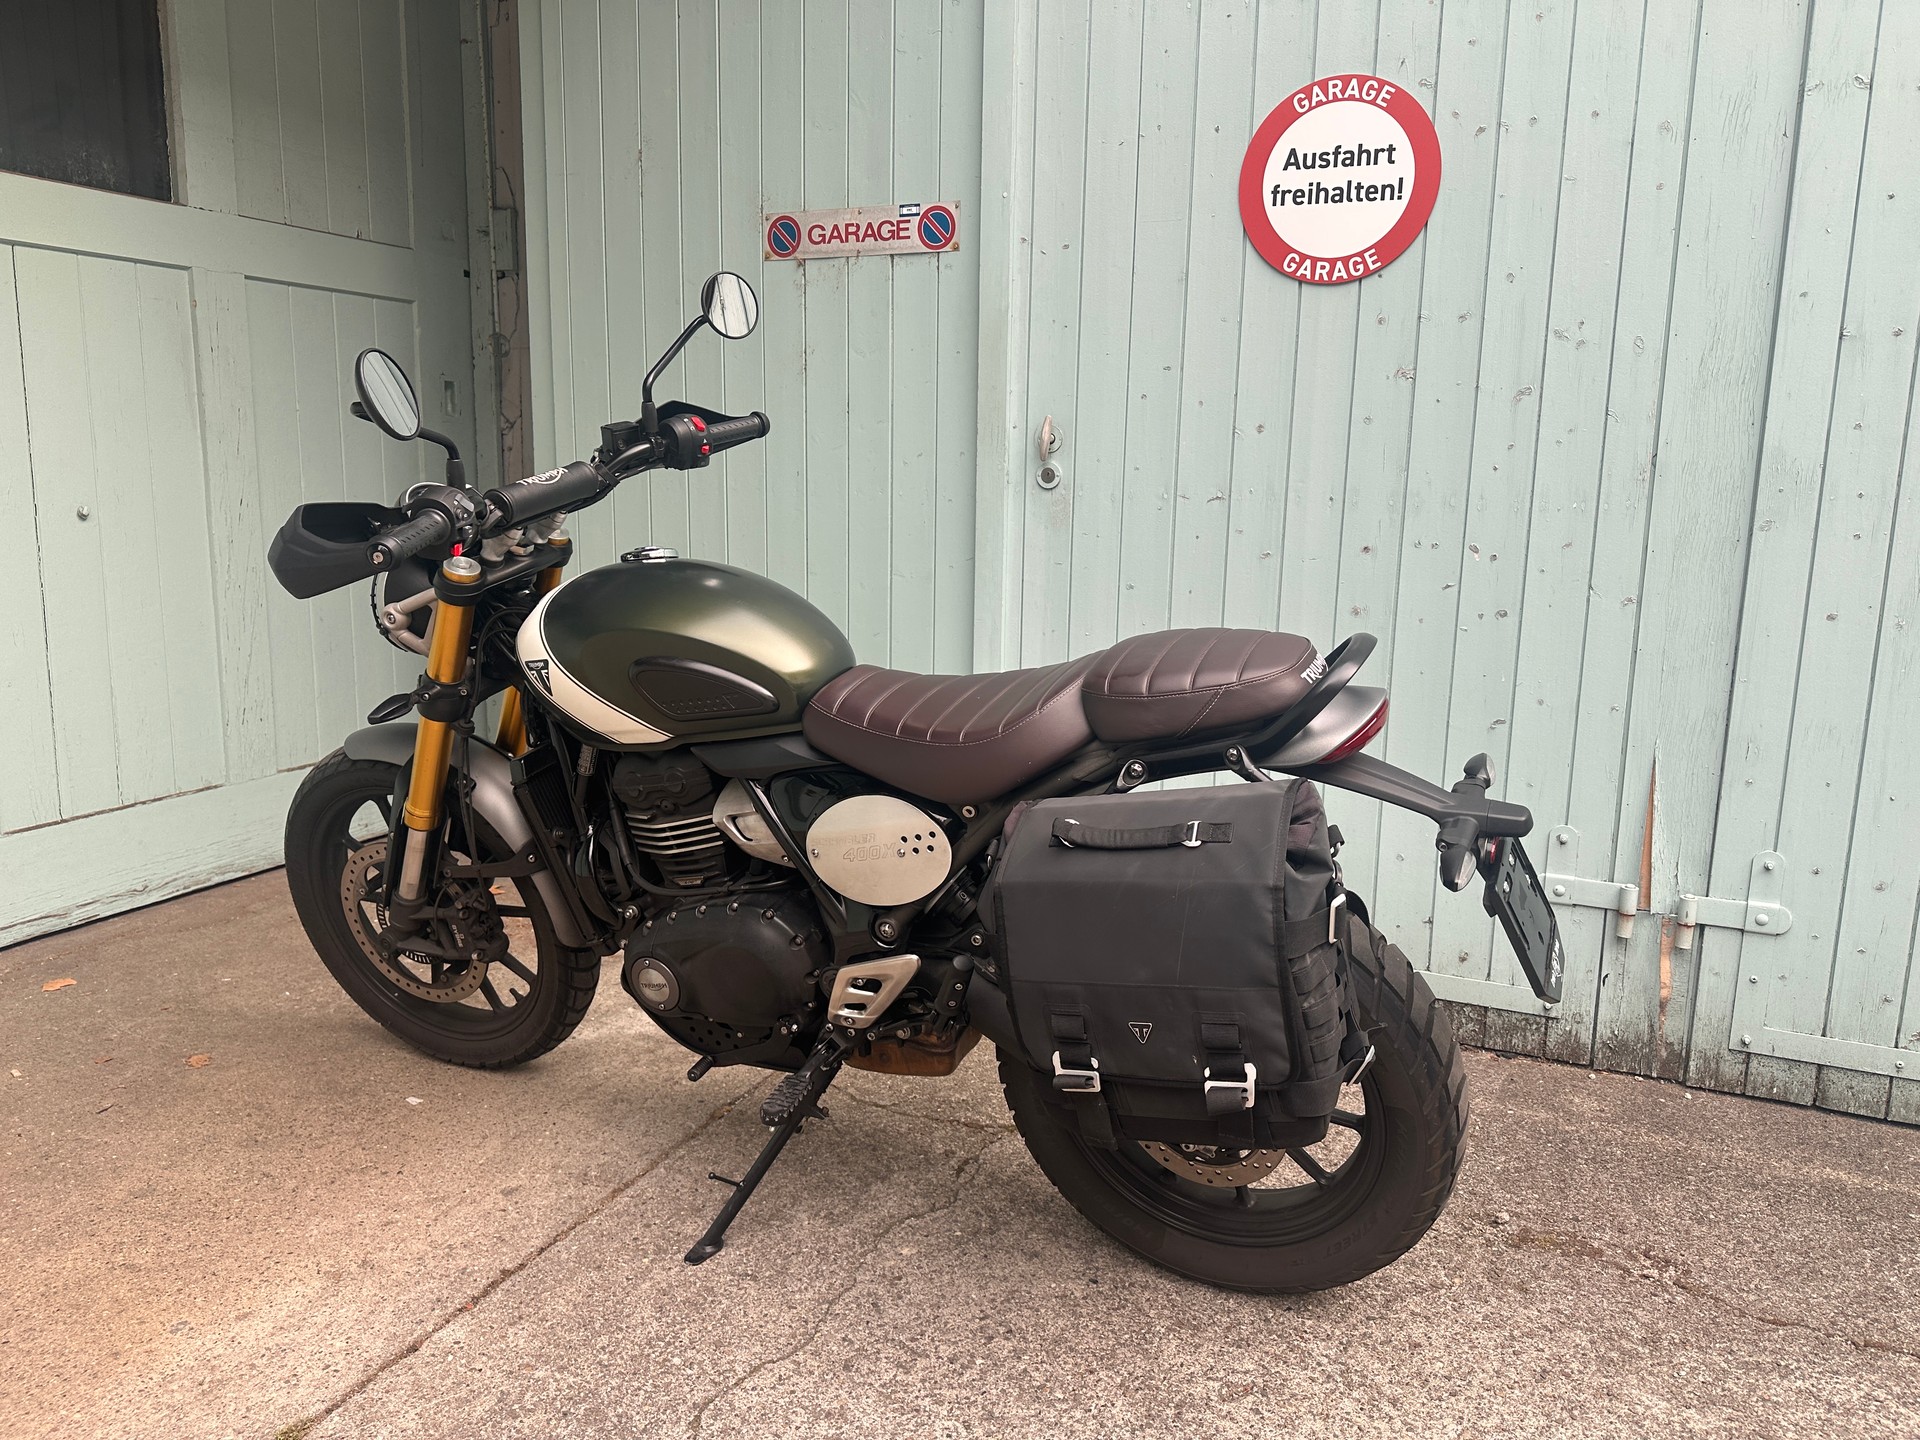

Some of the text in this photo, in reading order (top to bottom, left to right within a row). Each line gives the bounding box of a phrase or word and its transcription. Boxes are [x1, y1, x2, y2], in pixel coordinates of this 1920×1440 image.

[1293, 78, 1396, 113] GARAGE
[1282, 143, 1396, 171] Ausfahrt
[1271, 177, 1404, 207] freihalten!
[807, 219, 911, 246] GARAGE
[1282, 248, 1382, 281] GARAGE
[842, 842, 897, 862] 400X
